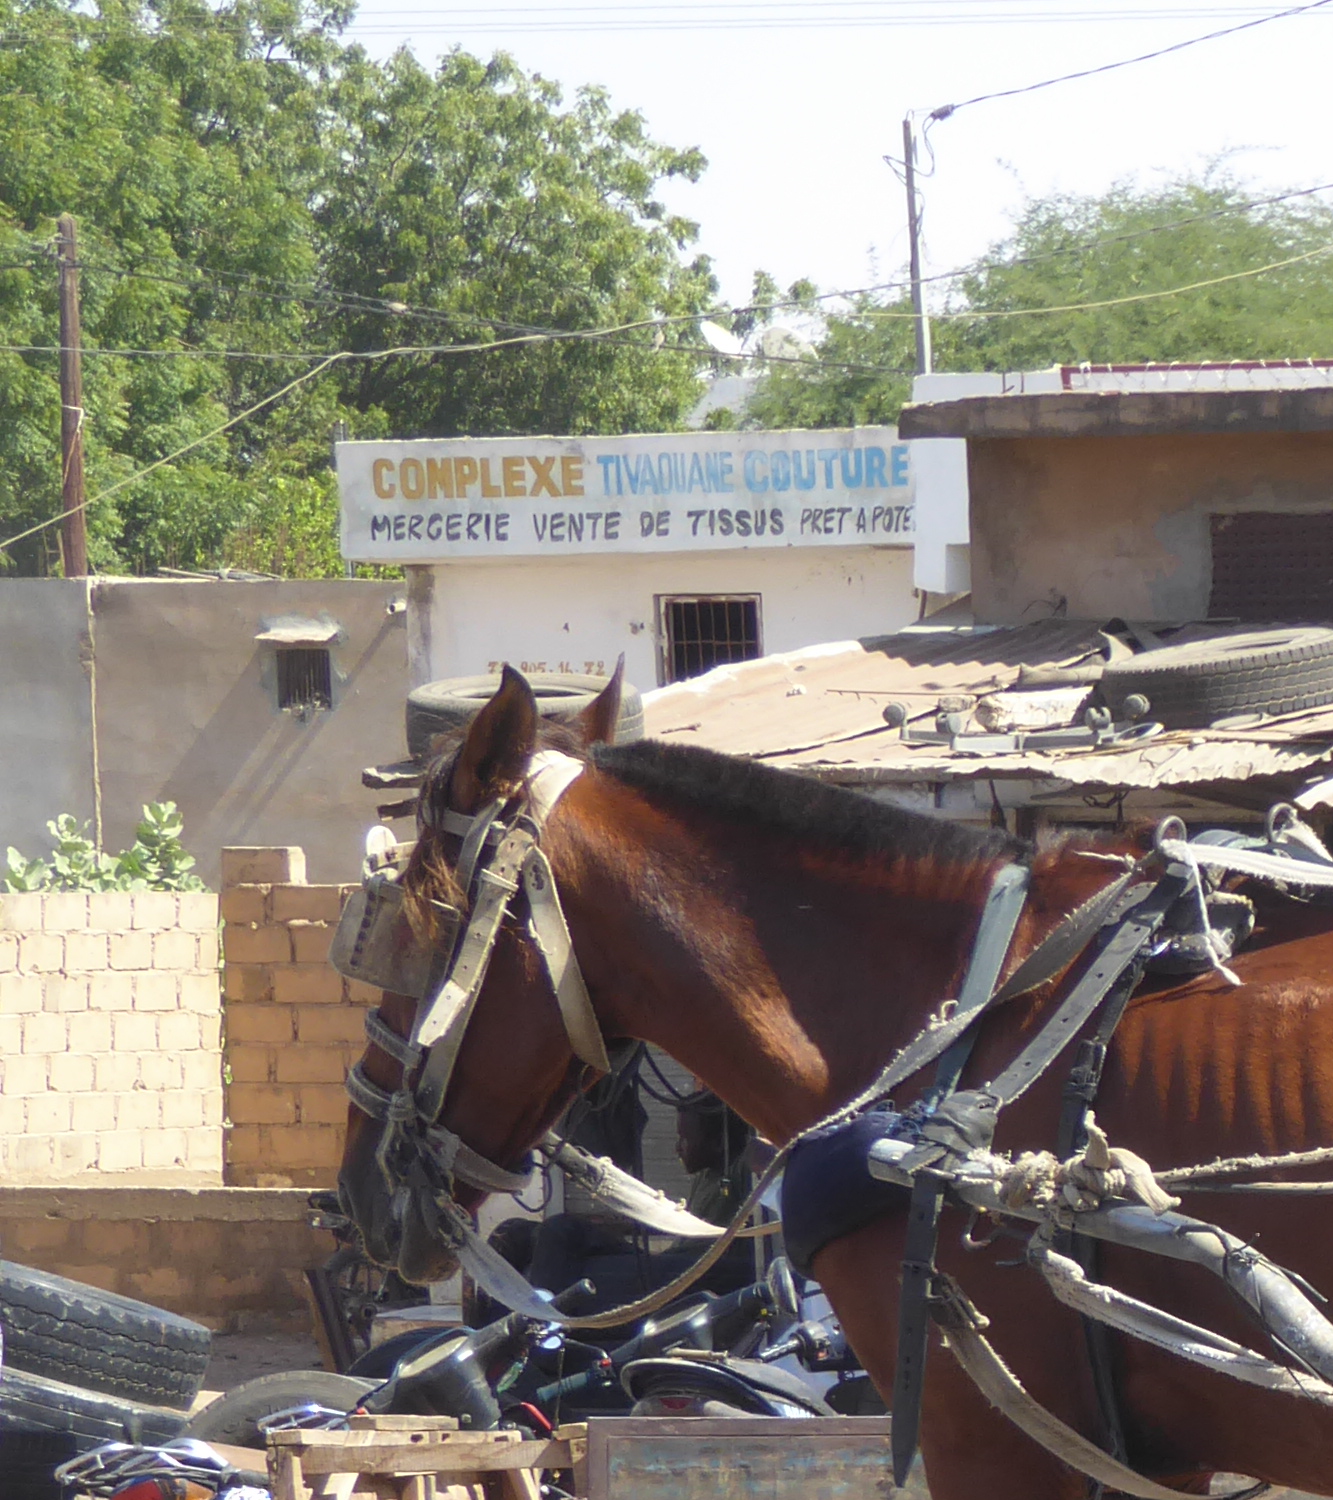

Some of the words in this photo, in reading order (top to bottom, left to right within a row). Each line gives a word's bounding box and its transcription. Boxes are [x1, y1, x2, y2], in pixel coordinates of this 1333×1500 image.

[372, 456, 585, 500] COMPLEXE
[597, 452, 735, 496] TIVAOUANE
[744, 445, 909, 493] COUTURE
[533, 511, 622, 542] VENTE
[640, 510, 671, 538] DE
[687, 507, 785, 538] TISSUS
[800, 507, 853, 535] PRET
[856, 506, 876, 534] A
[872, 504, 916, 533] POTE
